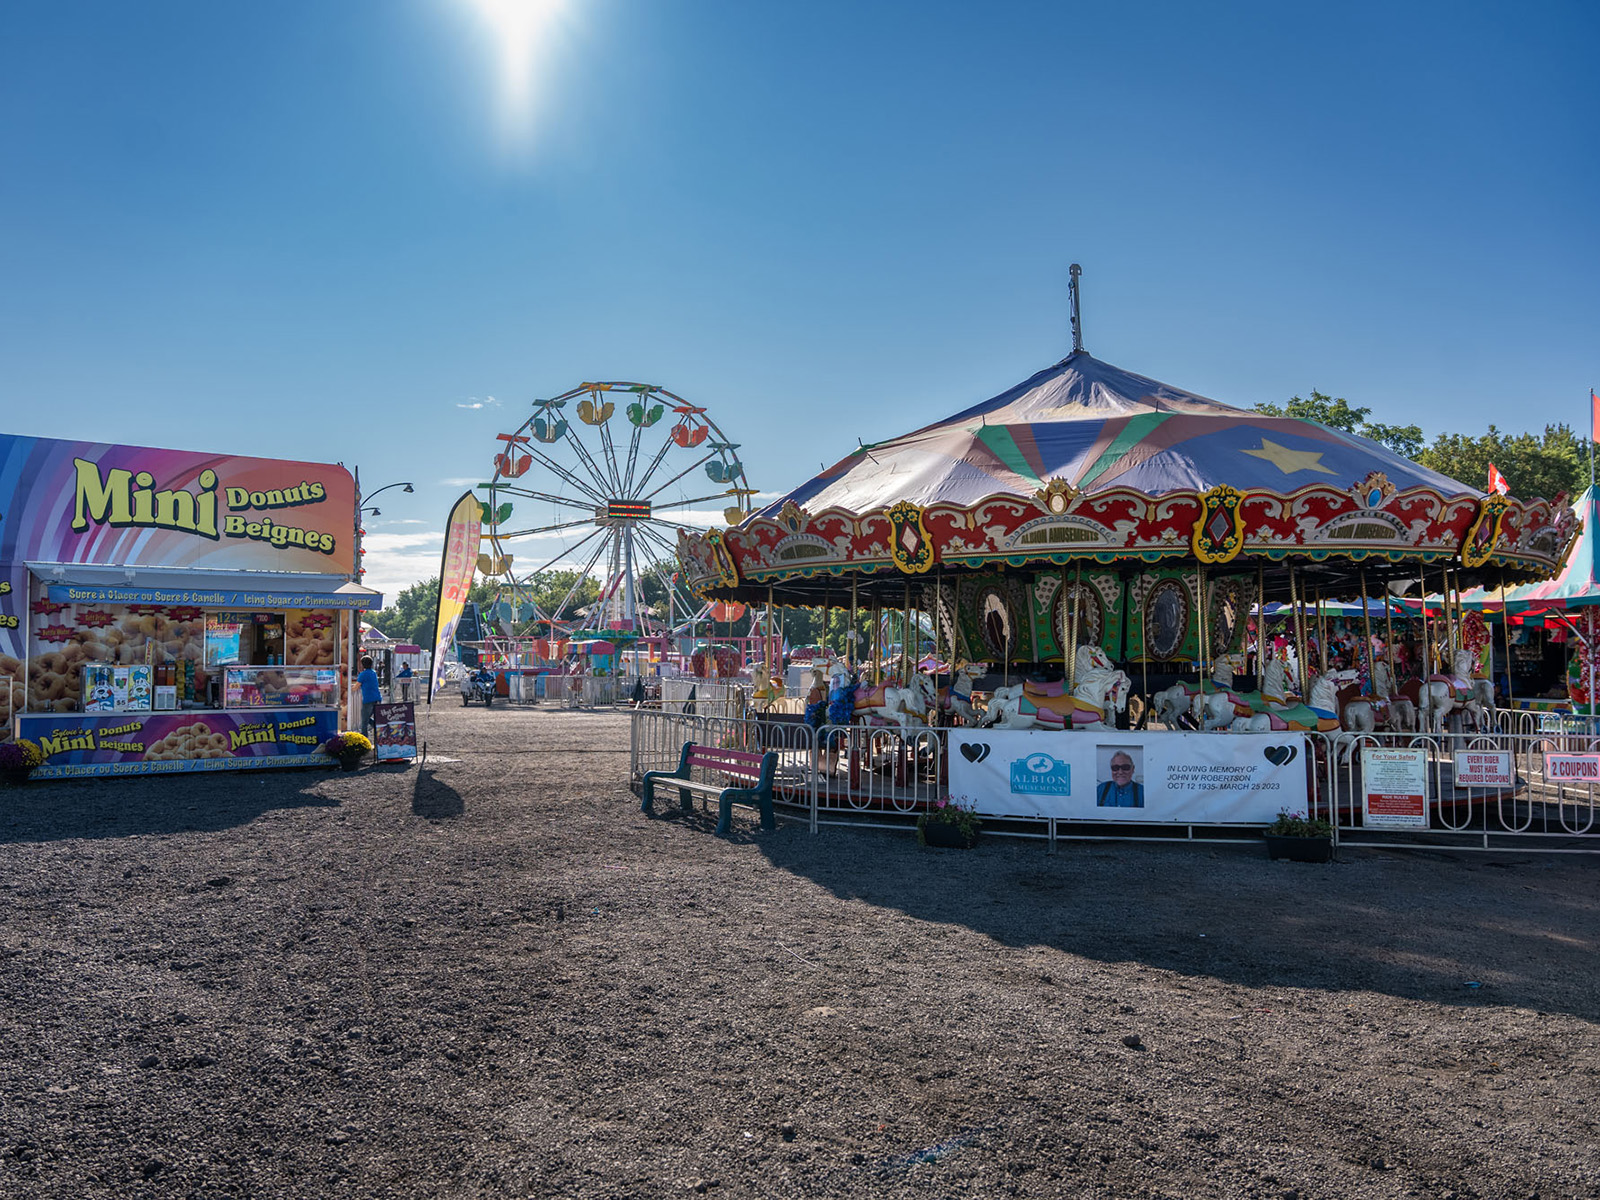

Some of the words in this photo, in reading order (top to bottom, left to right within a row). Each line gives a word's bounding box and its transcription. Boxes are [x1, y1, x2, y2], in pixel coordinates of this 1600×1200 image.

[71, 458, 219, 539] Mini
[226, 481, 326, 510] Donuts
[224, 515, 335, 554] Beignes
[1049, 527, 1099, 543] AMUSEMENTS
[443, 521, 466, 600] SLUSH
[69, 588, 97, 599] Sucre
[108, 590, 138, 601] Glacer
[141, 593, 152, 601] ou
[155, 591, 181, 602] Sucre
[183, 593, 190, 602] &
[192, 593, 225, 604] Canelle
[244, 594, 265, 606] Icing
[267, 595, 292, 606] Sugar
[293, 597, 303, 606] or
[305, 597, 347, 607] Cinnamon
[348, 597, 371, 607] Sugar
[52, 727, 83, 738] Sylvie's
[228, 723, 276, 750] Mini
[279, 716, 316, 730] Donuts
[279, 733, 318, 745] Beignes
[39, 729, 96, 759] Mini
[99, 721, 142, 737] Donuts
[99, 741, 144, 753] Beignes
[64, 764, 97, 776] Glacer
[99, 765, 110, 775] ou
[113, 762, 139, 773] Sucre
[141, 763, 149, 773] &
[151, 760, 184, 772] Canelle
[204, 759, 225, 770] Icing
[227, 757, 252, 769] Sugar
[255, 759, 265, 767] or
[266, 755, 308, 765] Cinnamon
[310, 754, 332, 764] Sugar
[1467, 755, 1483, 764] EVERY
[1484, 756, 1499, 764] RIDER
[1177, 765, 1207, 773] LOVING
[1469, 765, 1483, 773] MUST
[1484, 765, 1498, 773] HAVE
[1552, 762, 1557, 776] 2
[1560, 762, 1598, 777] COUPONS
[1013, 774, 1067, 784] ALBION
[1459, 774, 1483, 783] REQUIRED
[1484, 774, 1509, 783] COUPONS
[1167, 782, 1185, 790] OCT
[1187, 782, 1196, 790] 12
[1261, 782, 1280, 790] 2023
